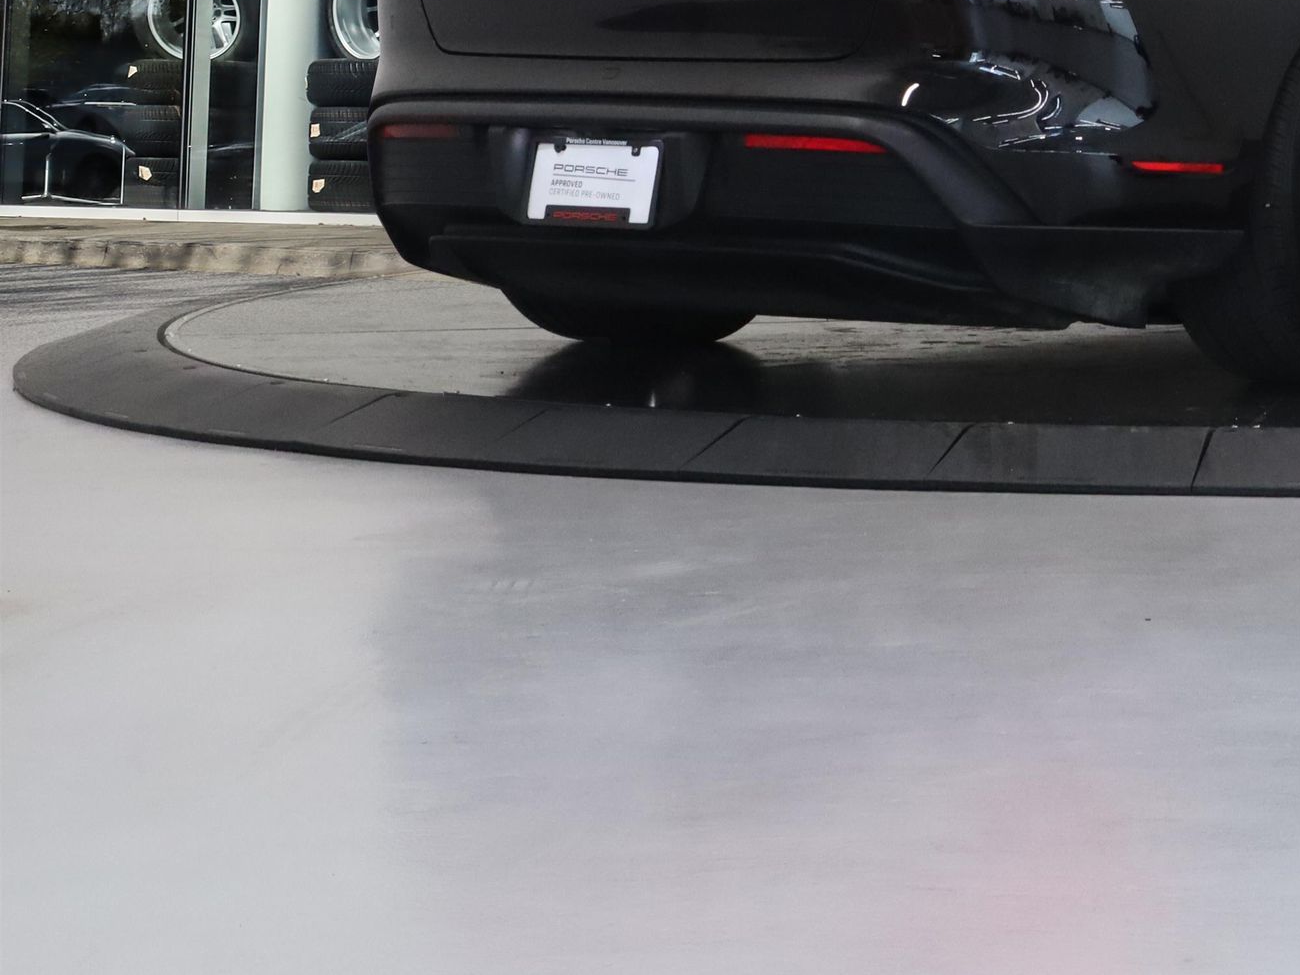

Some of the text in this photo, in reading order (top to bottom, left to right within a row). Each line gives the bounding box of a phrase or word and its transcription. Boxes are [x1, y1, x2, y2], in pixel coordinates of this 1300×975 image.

[553, 163, 629, 177] PORSCHE
[551, 179, 583, 188] APPROVED
[549, 187, 620, 201] CERTIFIED PRE-OWNED
[553, 211, 617, 222] PORSCHE
